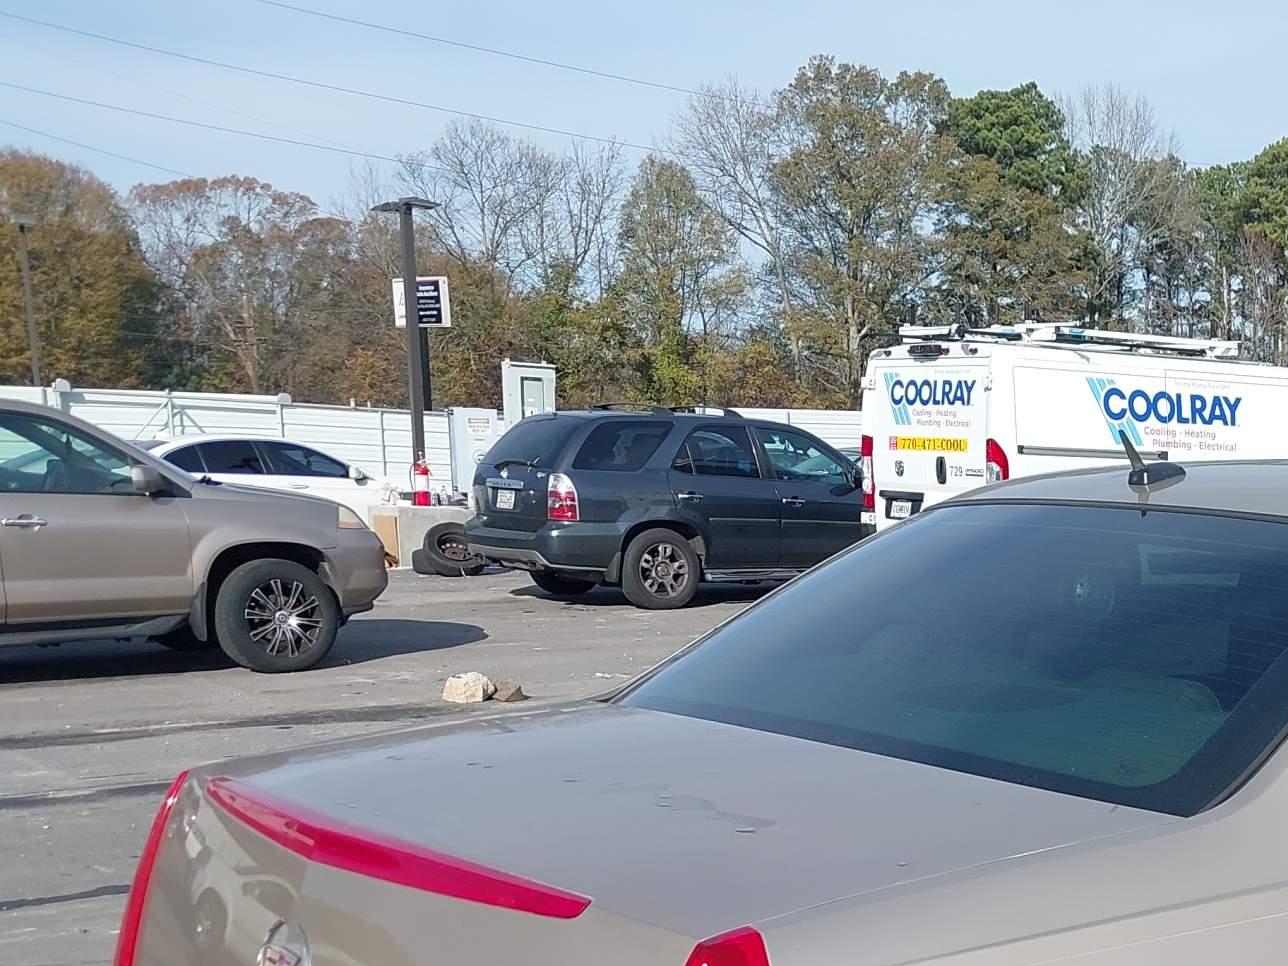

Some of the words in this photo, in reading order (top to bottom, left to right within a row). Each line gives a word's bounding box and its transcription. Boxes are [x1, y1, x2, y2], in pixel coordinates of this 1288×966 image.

[890, 379, 976, 406] COOLRAY
[912, 408, 933, 418] Cooling
[936, 409, 957, 419] Heating
[1103, 387, 1242, 427] COOLRAY
[917, 419, 941, 428] Plumbing
[1143, 426, 1177, 439] Cooling
[1184, 428, 1217, 441] Heating
[901, 438, 966, 452] 770-471-COOL
[1152, 438, 1192, 451] Plumbing
[1199, 440, 1237, 453] Electrical
[949, 465, 963, 477] 729
